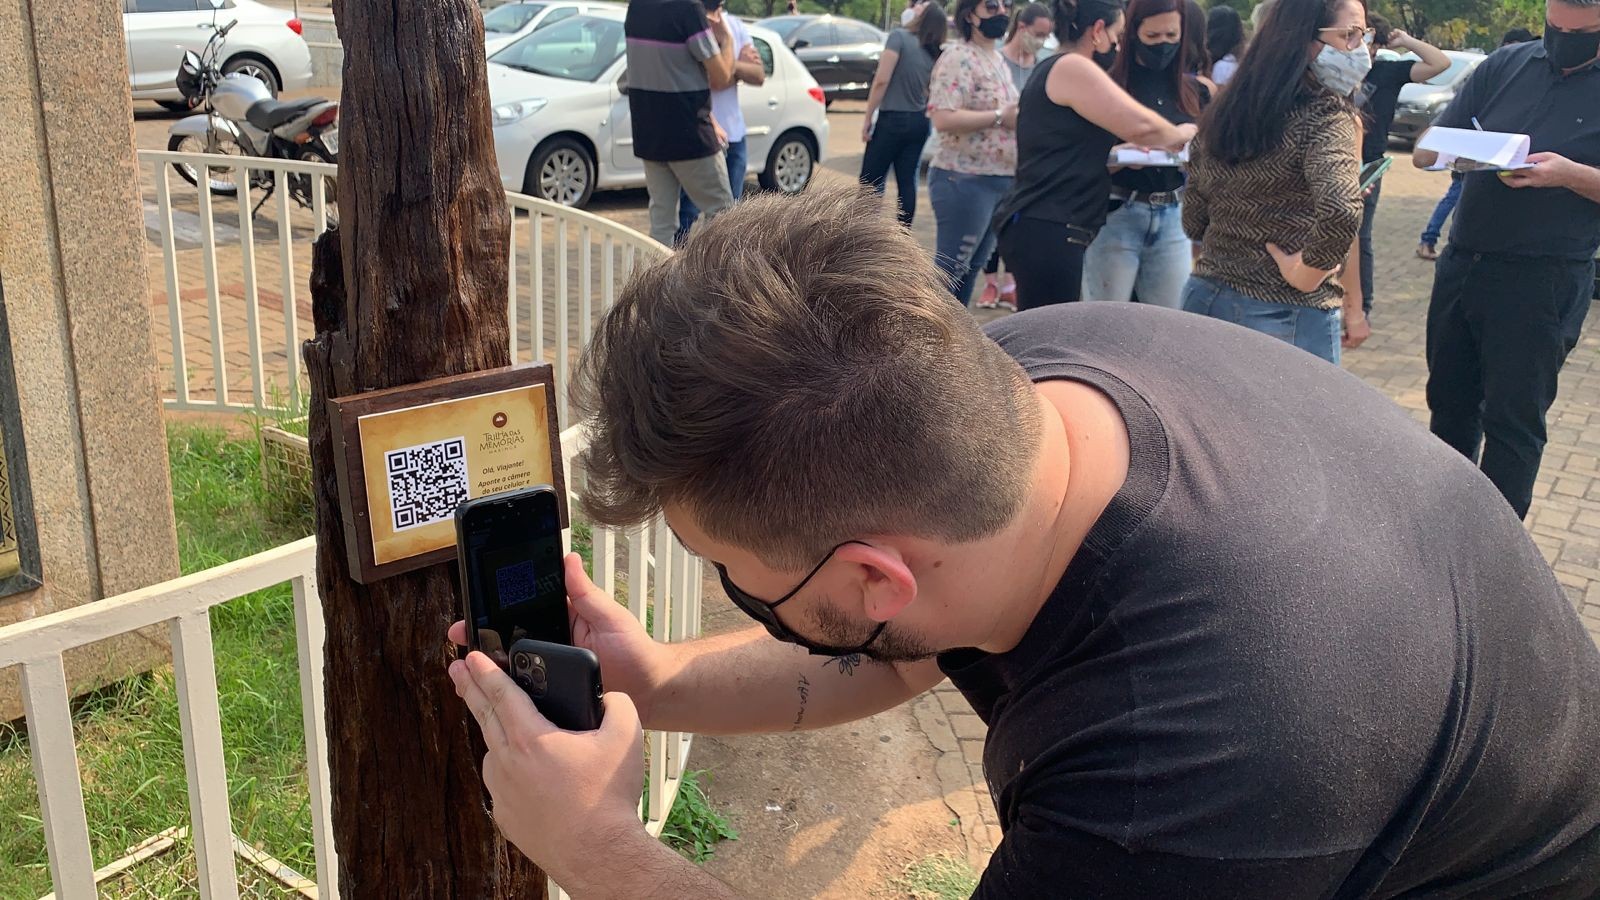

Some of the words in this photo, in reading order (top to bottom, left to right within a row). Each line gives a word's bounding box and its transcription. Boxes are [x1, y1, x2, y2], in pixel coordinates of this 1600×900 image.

[496, 460, 524, 472] Viajante!
[478, 478, 501, 488] Aponte
[507, 471, 531, 480] câmera
[482, 486, 491, 495] do
[491, 484, 503, 493] seu
[503, 479, 526, 490] celular
